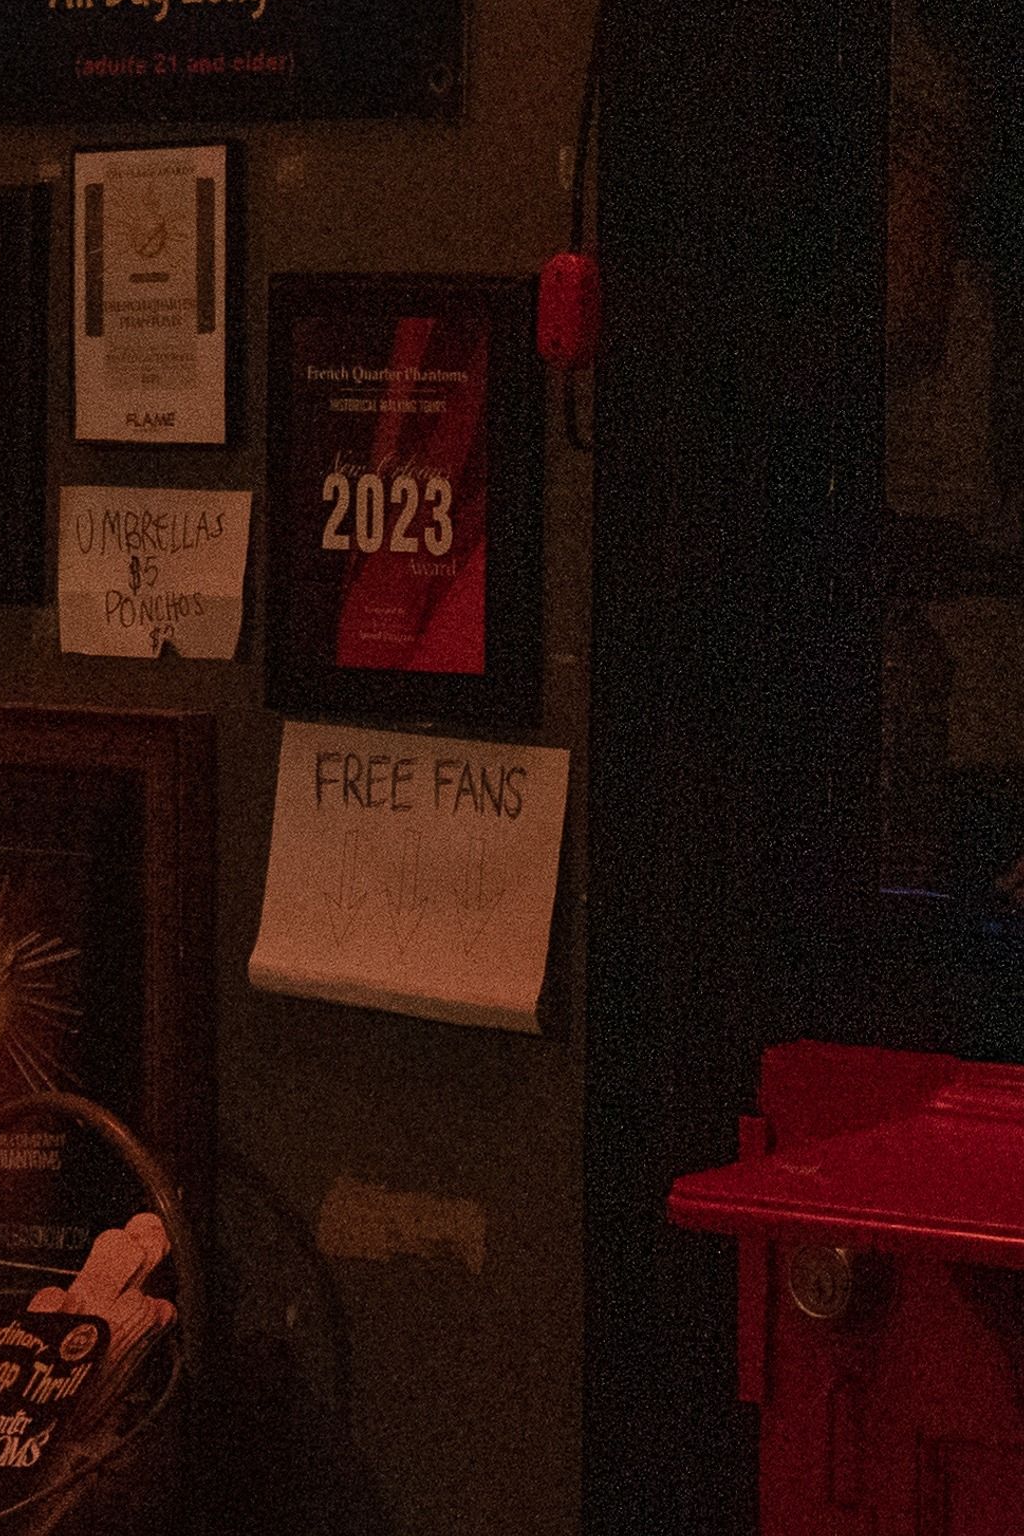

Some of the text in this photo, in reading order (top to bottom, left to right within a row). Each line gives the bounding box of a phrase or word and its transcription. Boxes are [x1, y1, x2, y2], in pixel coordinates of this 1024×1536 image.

[154, 52, 179, 76] 21
[187, 52, 226, 75] and
[306, 364, 469, 384] French Quarter Phantoms
[76, 509, 225, 555] UMBRELLAS
[321, 471, 454, 558] 2023
[105, 589, 205, 628] PONCHOS
[315, 752, 526, 820] FREE FANS
[22, 1360, 94, 1405] Thrill
